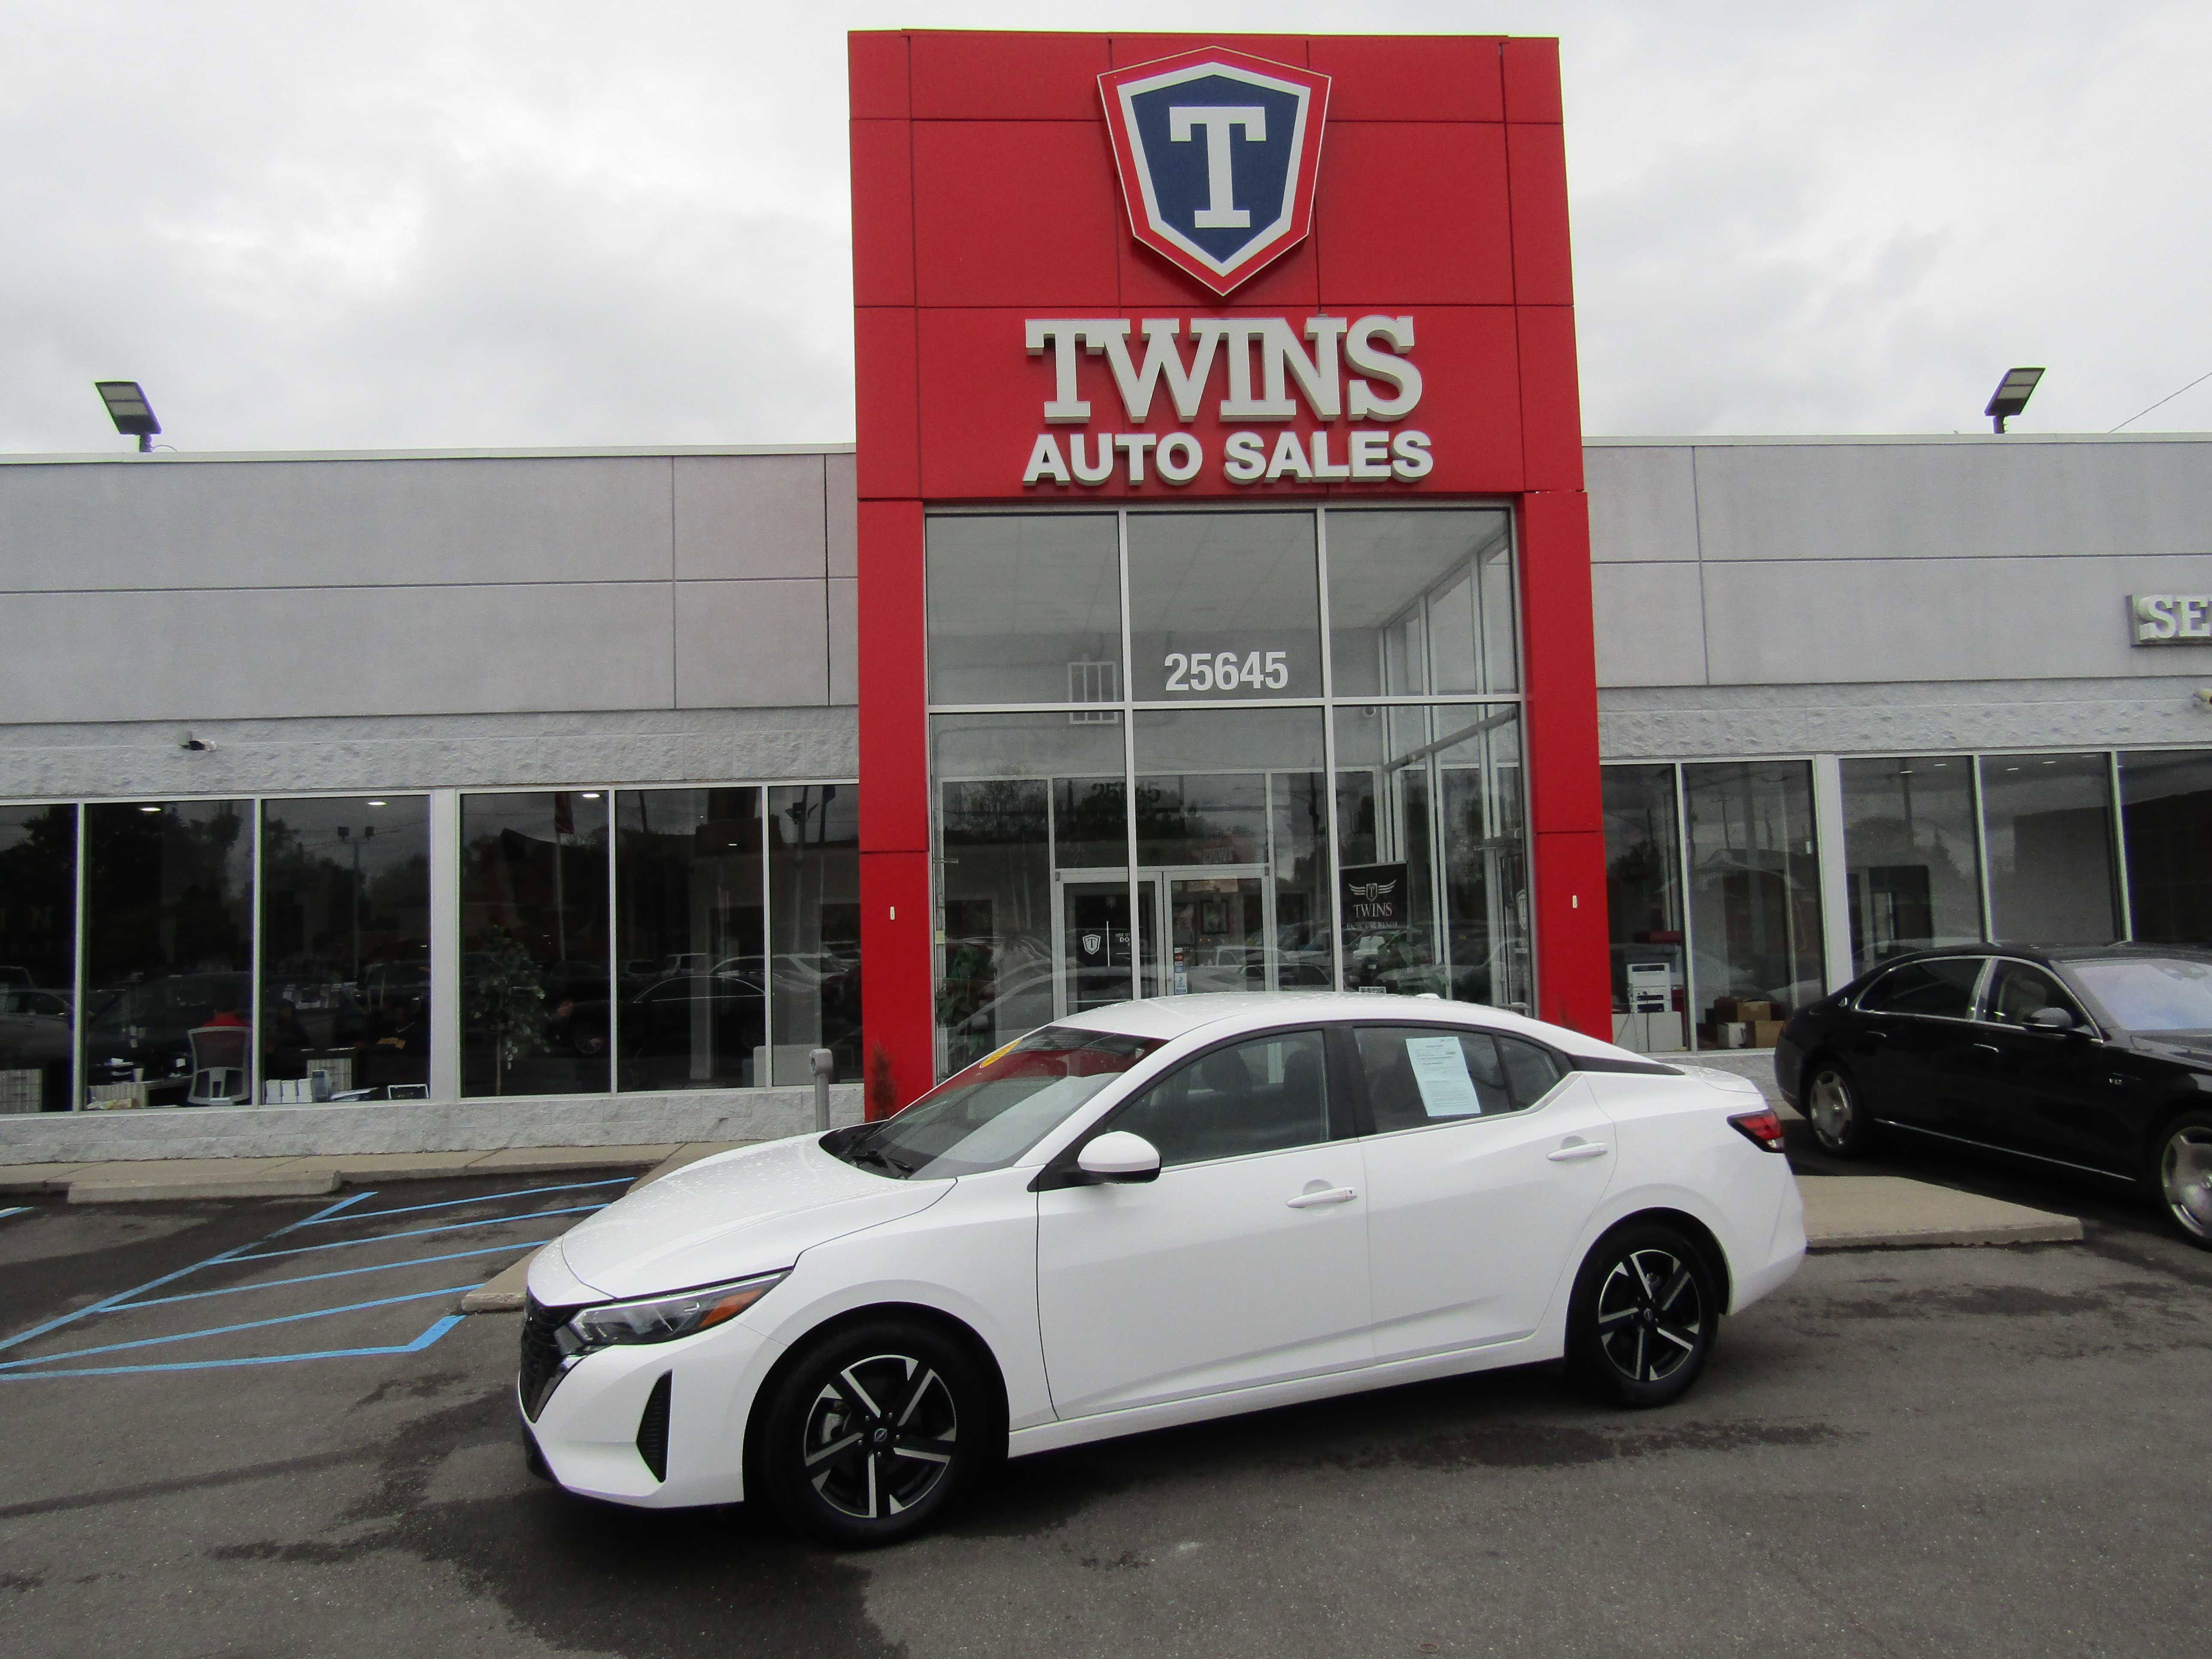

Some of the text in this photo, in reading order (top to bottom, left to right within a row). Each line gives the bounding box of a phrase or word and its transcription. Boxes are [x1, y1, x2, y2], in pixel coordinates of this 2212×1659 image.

[1169, 106, 1266, 228] T
[1025, 315, 1422, 423] TWINS
[1022, 430, 1434, 486] AUTO SALES
[2138, 595, 2212, 639] SE
[1164, 651, 1288, 691] 25645
[1353, 902, 1392, 918] TWINS
[1088, 938, 1096, 948] T
